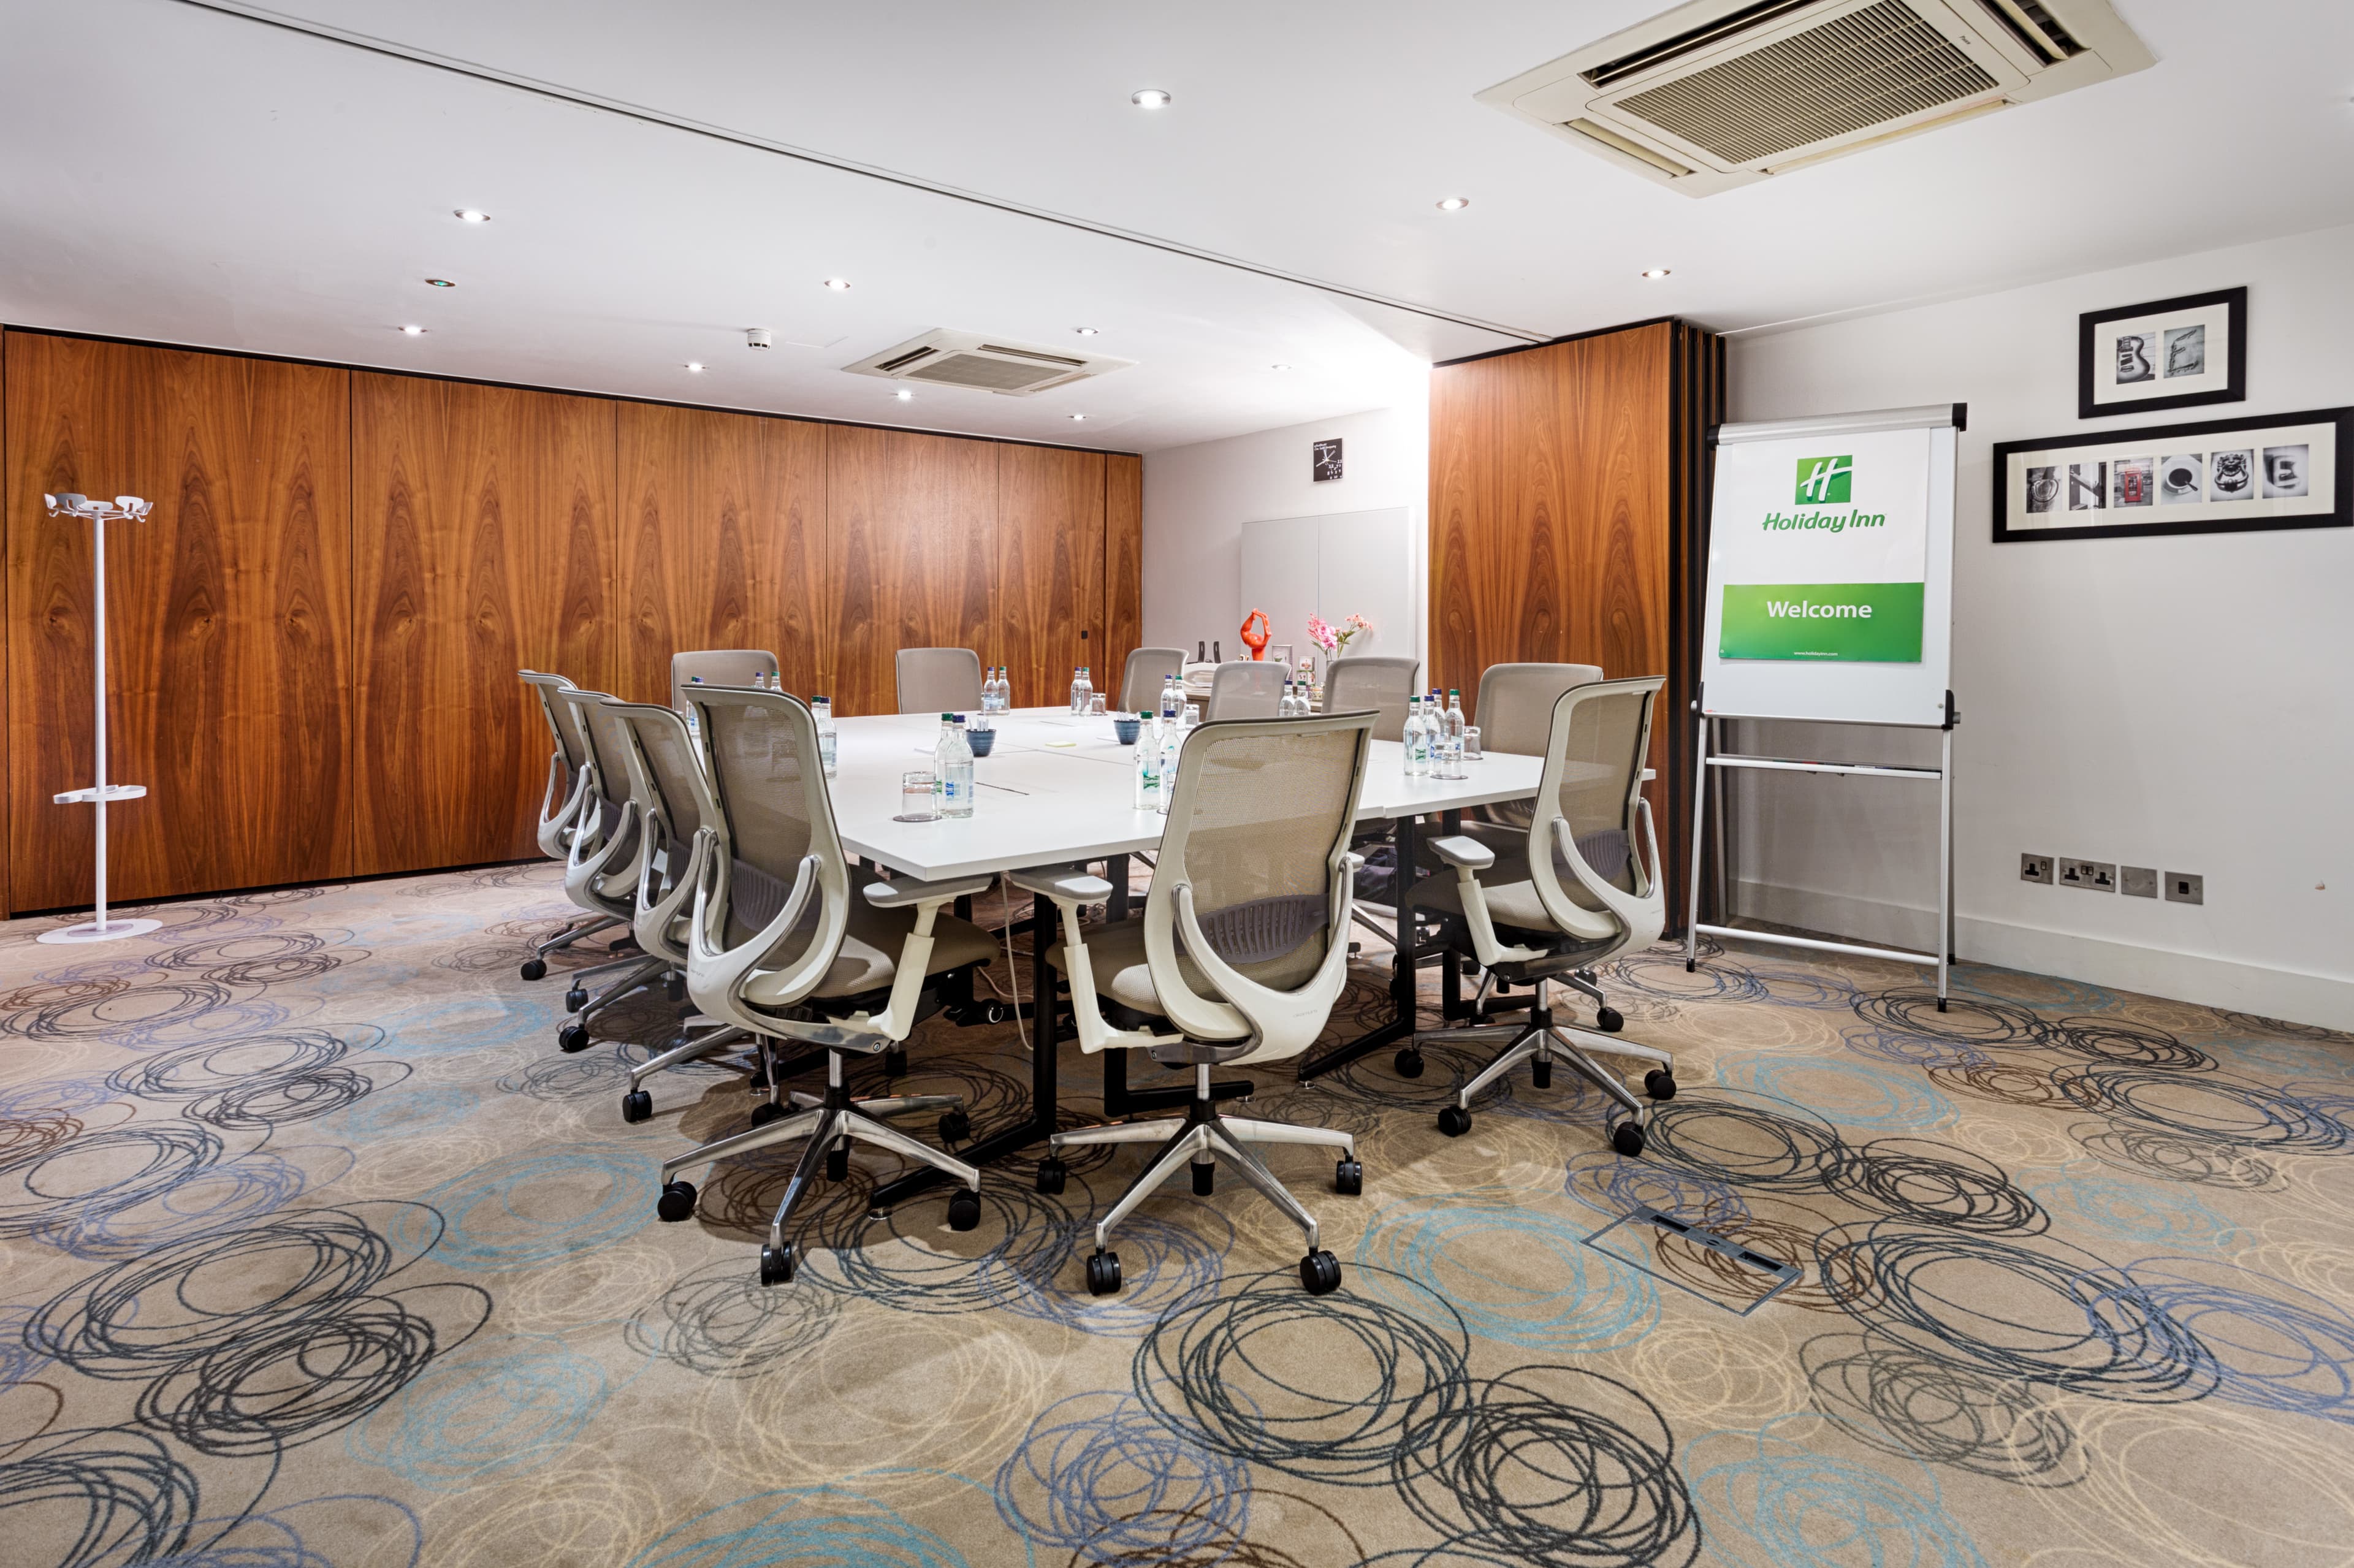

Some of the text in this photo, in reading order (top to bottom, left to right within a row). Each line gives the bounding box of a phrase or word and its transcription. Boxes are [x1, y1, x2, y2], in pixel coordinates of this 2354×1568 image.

[1762, 509, 1885, 533] Holiday Inn
[1767, 600, 1872, 618] Welcome
